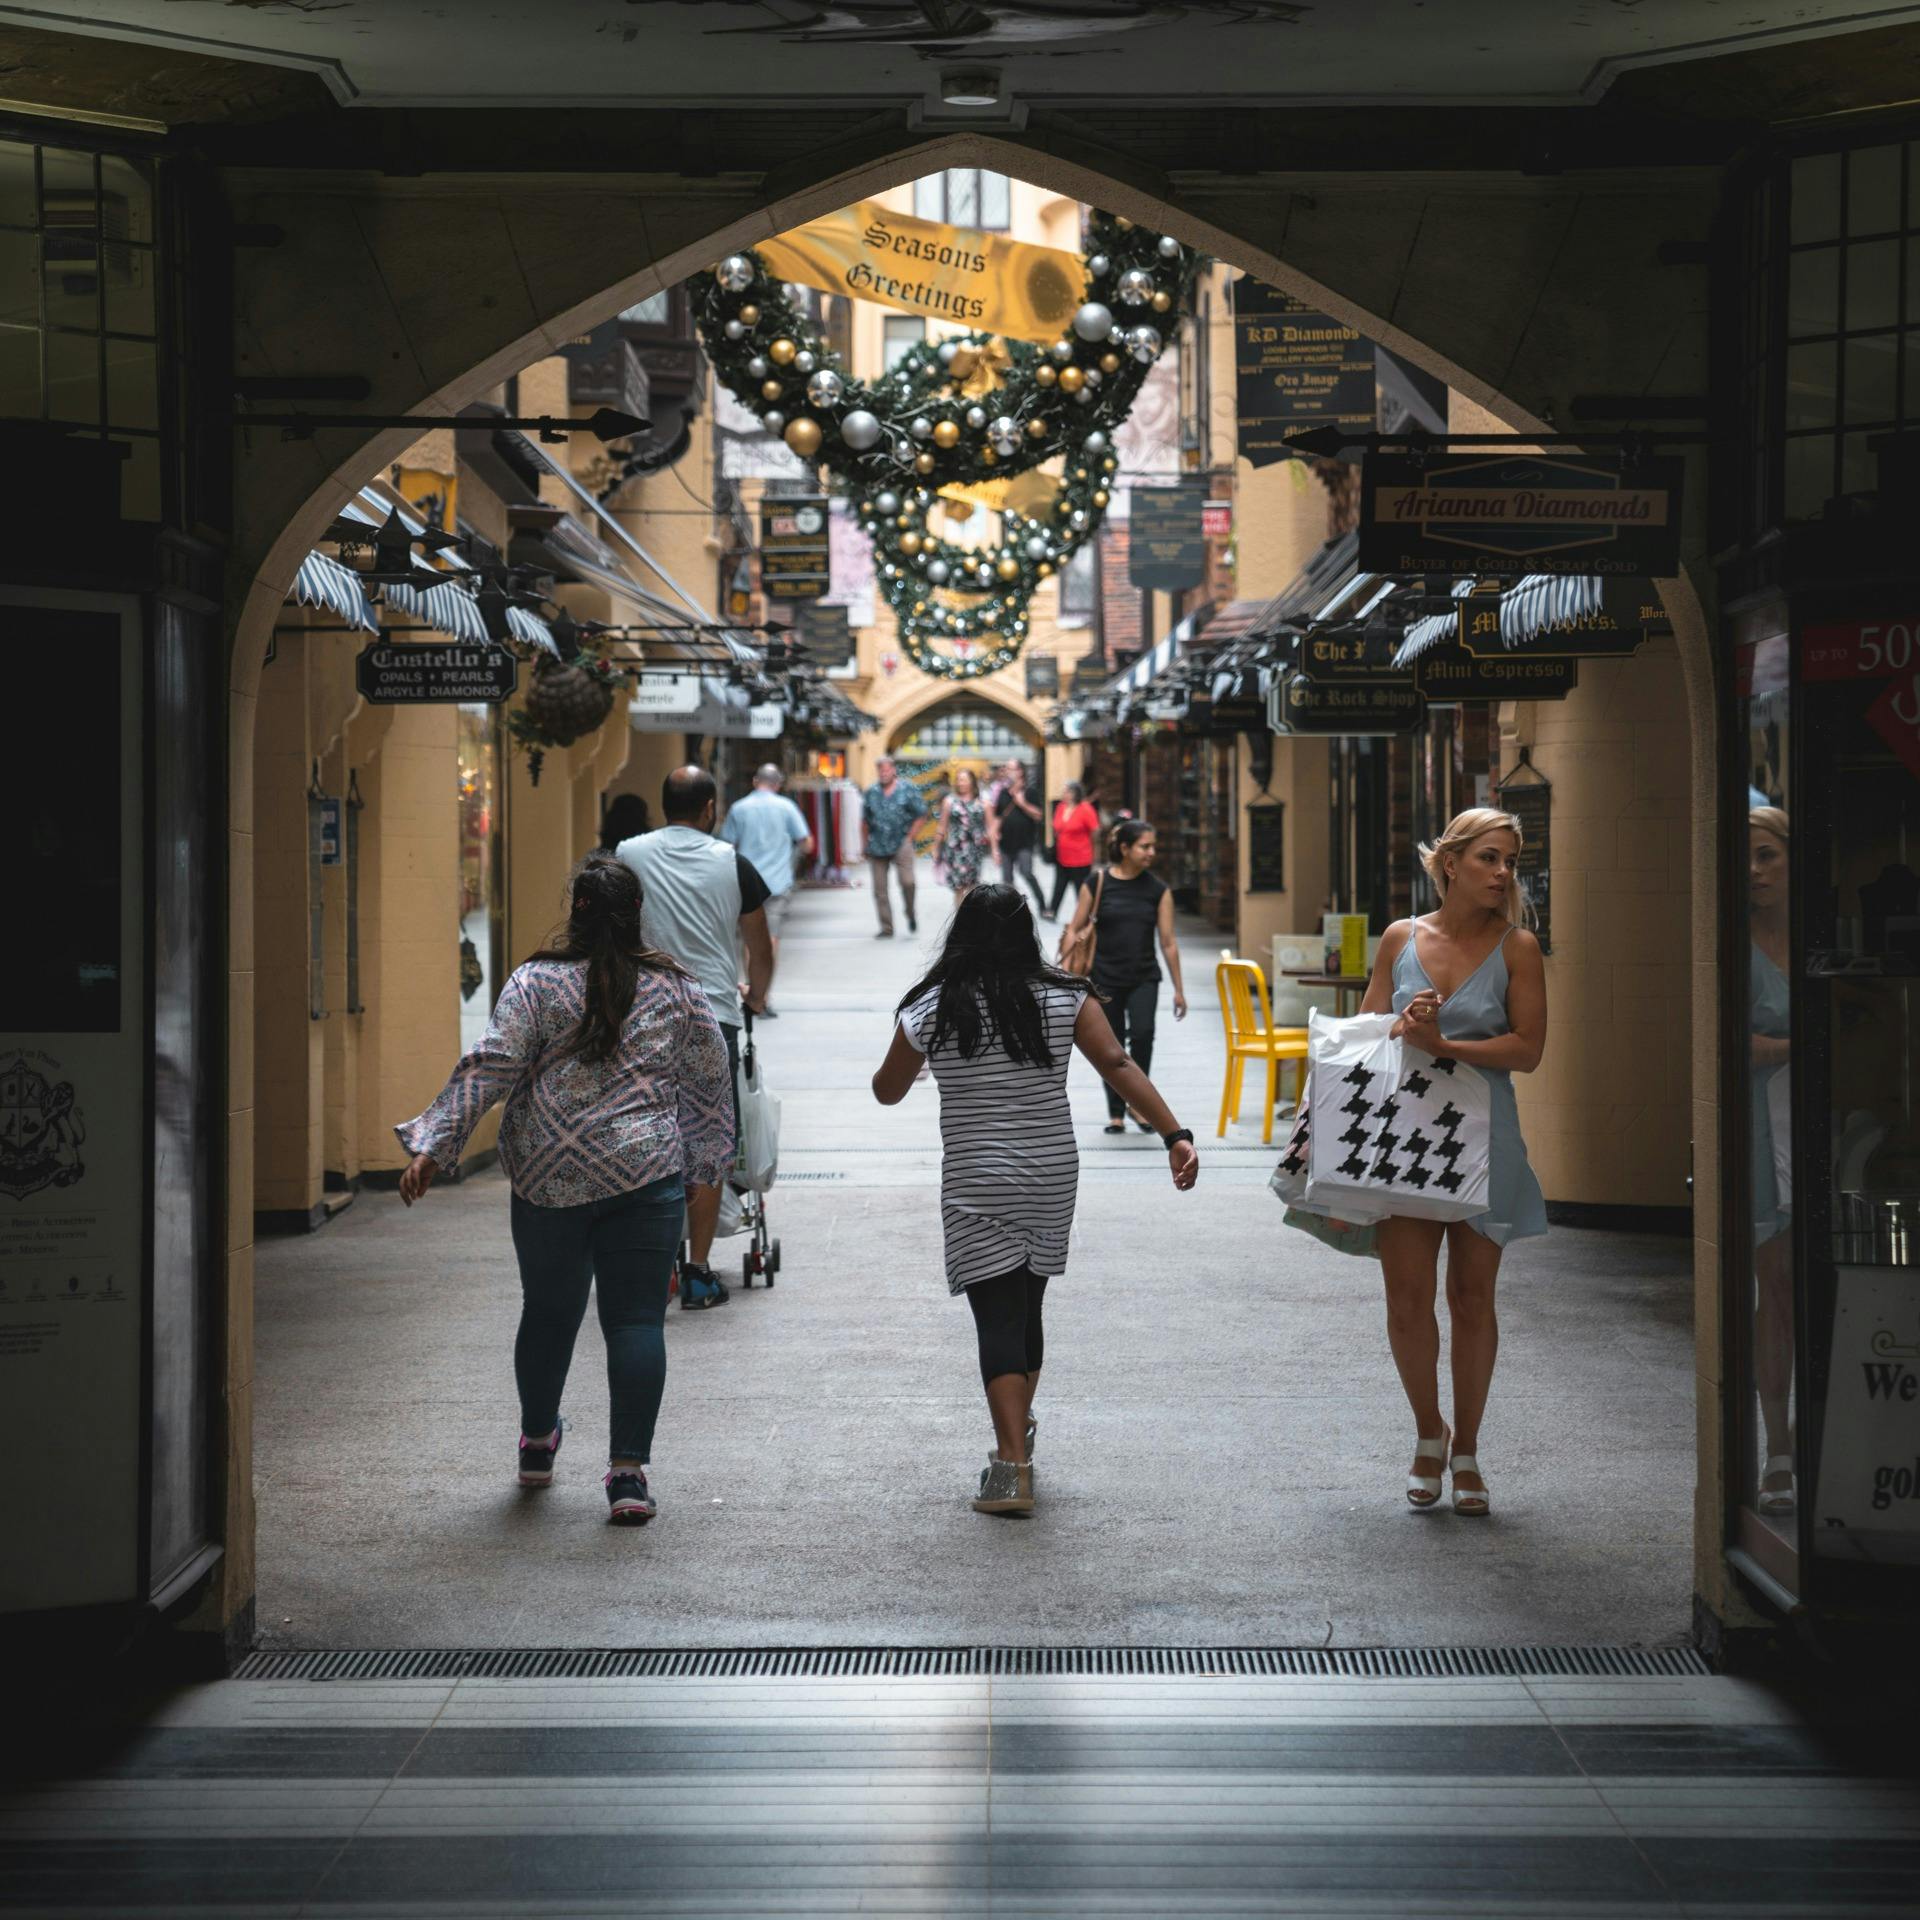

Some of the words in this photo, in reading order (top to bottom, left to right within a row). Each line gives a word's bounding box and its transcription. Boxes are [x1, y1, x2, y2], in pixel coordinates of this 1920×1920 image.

[862, 221, 987, 273] Seasons
[846, 263, 986, 319] Greetings
[1247, 326, 1278, 343] KD
[1282, 326, 1360, 342] Diamonds
[1394, 491, 1505, 519] Arianna
[1514, 491, 1650, 519] Diamonds
[1400, 556, 1446, 570] BUYER
[1452, 559, 1471, 571] OF
[1475, 556, 1521, 571] GOLD
[1523, 557, 1538, 571] &
[1543, 557, 1590, 572] SCRAP
[1594, 558, 1638, 573] GOLD
[371, 648, 503, 668] Costello's
[1312, 640, 1349, 662] The
[380, 671, 423, 683] OPALS
[442, 671, 494, 683] PEARLS
[1424, 659, 1473, 681] Mini
[1479, 660, 1565, 680] Espresso
[374, 686, 425, 698] ARGYLE
[430, 685, 501, 698] DIAMONDS
[1290, 688, 1320, 707] The
[1327, 688, 1367, 706] Rock
[1373, 689, 1417, 708] Shop
[1862, 1363, 1918, 1401] We
